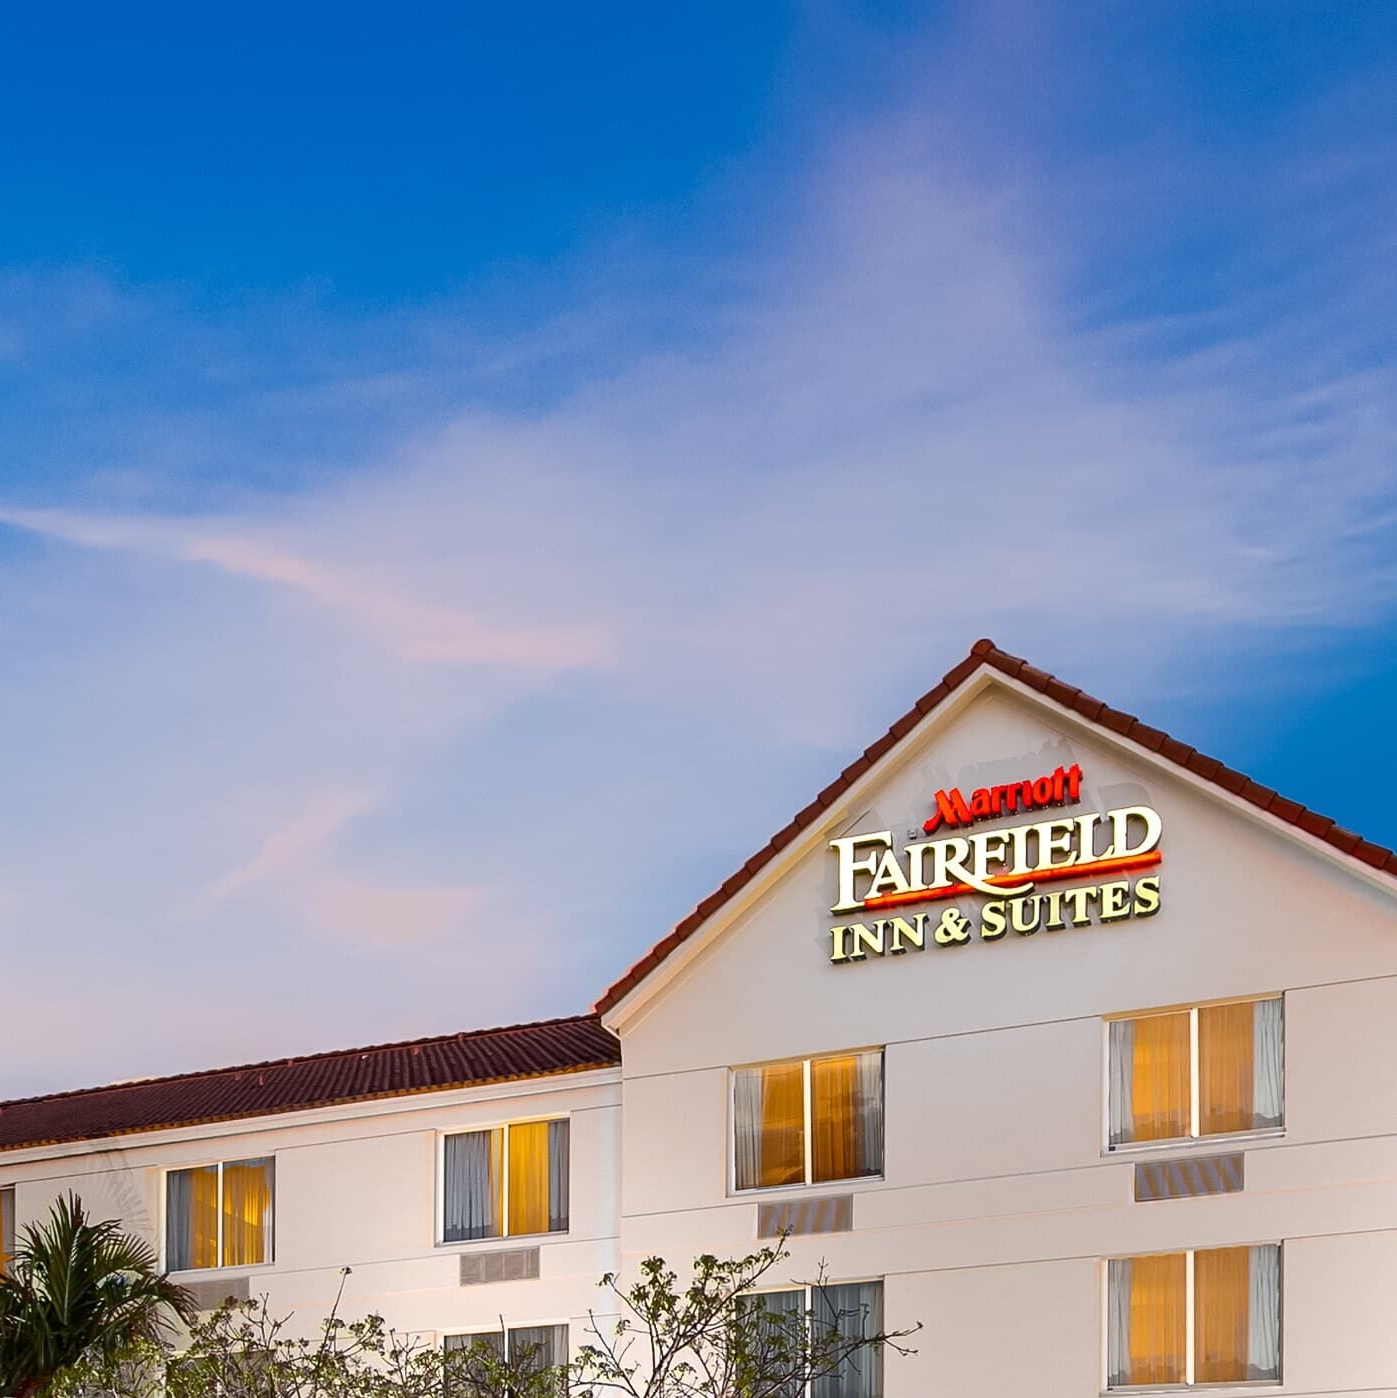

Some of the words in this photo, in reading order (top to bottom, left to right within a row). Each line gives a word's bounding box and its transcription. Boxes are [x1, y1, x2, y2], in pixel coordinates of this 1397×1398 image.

[922, 763, 1083, 835] Marriott
[828, 805, 1163, 915] FAIRFIELD
[829, 912, 929, 964] INN
[933, 906, 972, 947] &
[980, 874, 1162, 941] SUITES
